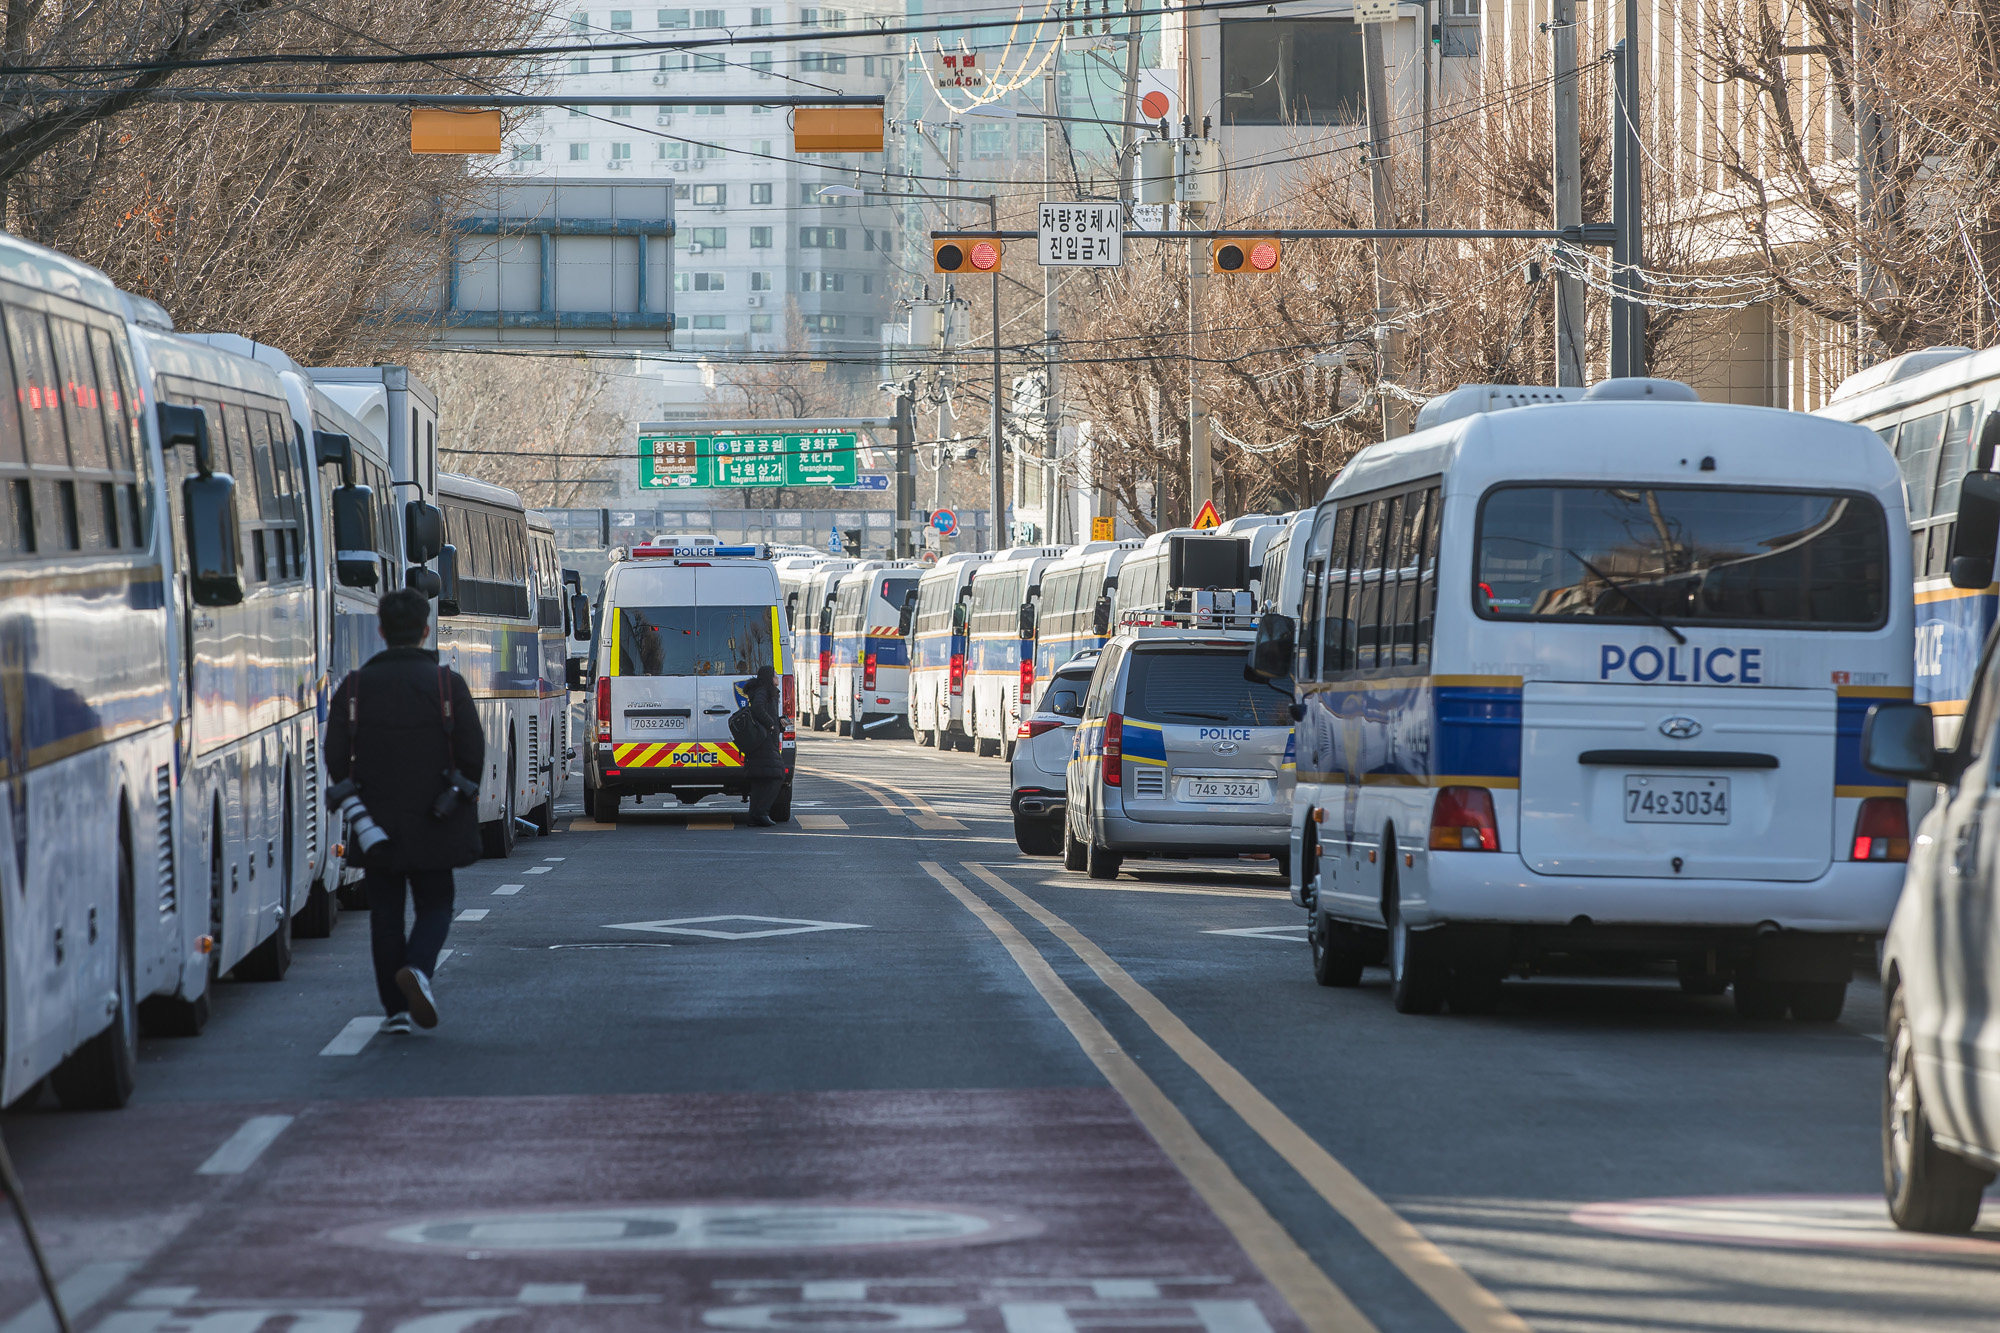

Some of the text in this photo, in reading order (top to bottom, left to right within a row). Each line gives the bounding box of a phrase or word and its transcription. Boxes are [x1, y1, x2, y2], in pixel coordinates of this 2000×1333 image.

[943, 55, 975, 68] 위험
[954, 69, 964, 77] kt
[1042, 208, 1118, 232] 차량정체시
[1050, 236, 1109, 260] 진입금지
[655, 441, 686, 453] 창덕궁
[718, 442, 725, 451] 6
[730, 440, 782, 453] 탑골공원
[730, 463, 783, 477] 낙원상가
[731, 475, 782, 485] Nagwon Market
[675, 547, 714, 557] POLICE
[1601, 645, 1761, 683] POLICE
[659, 719, 681, 728] 2490
[1200, 728, 1250, 740] POLICE
[673, 752, 717, 763] POLICE
[1195, 784, 1253, 796] 74오 3234
